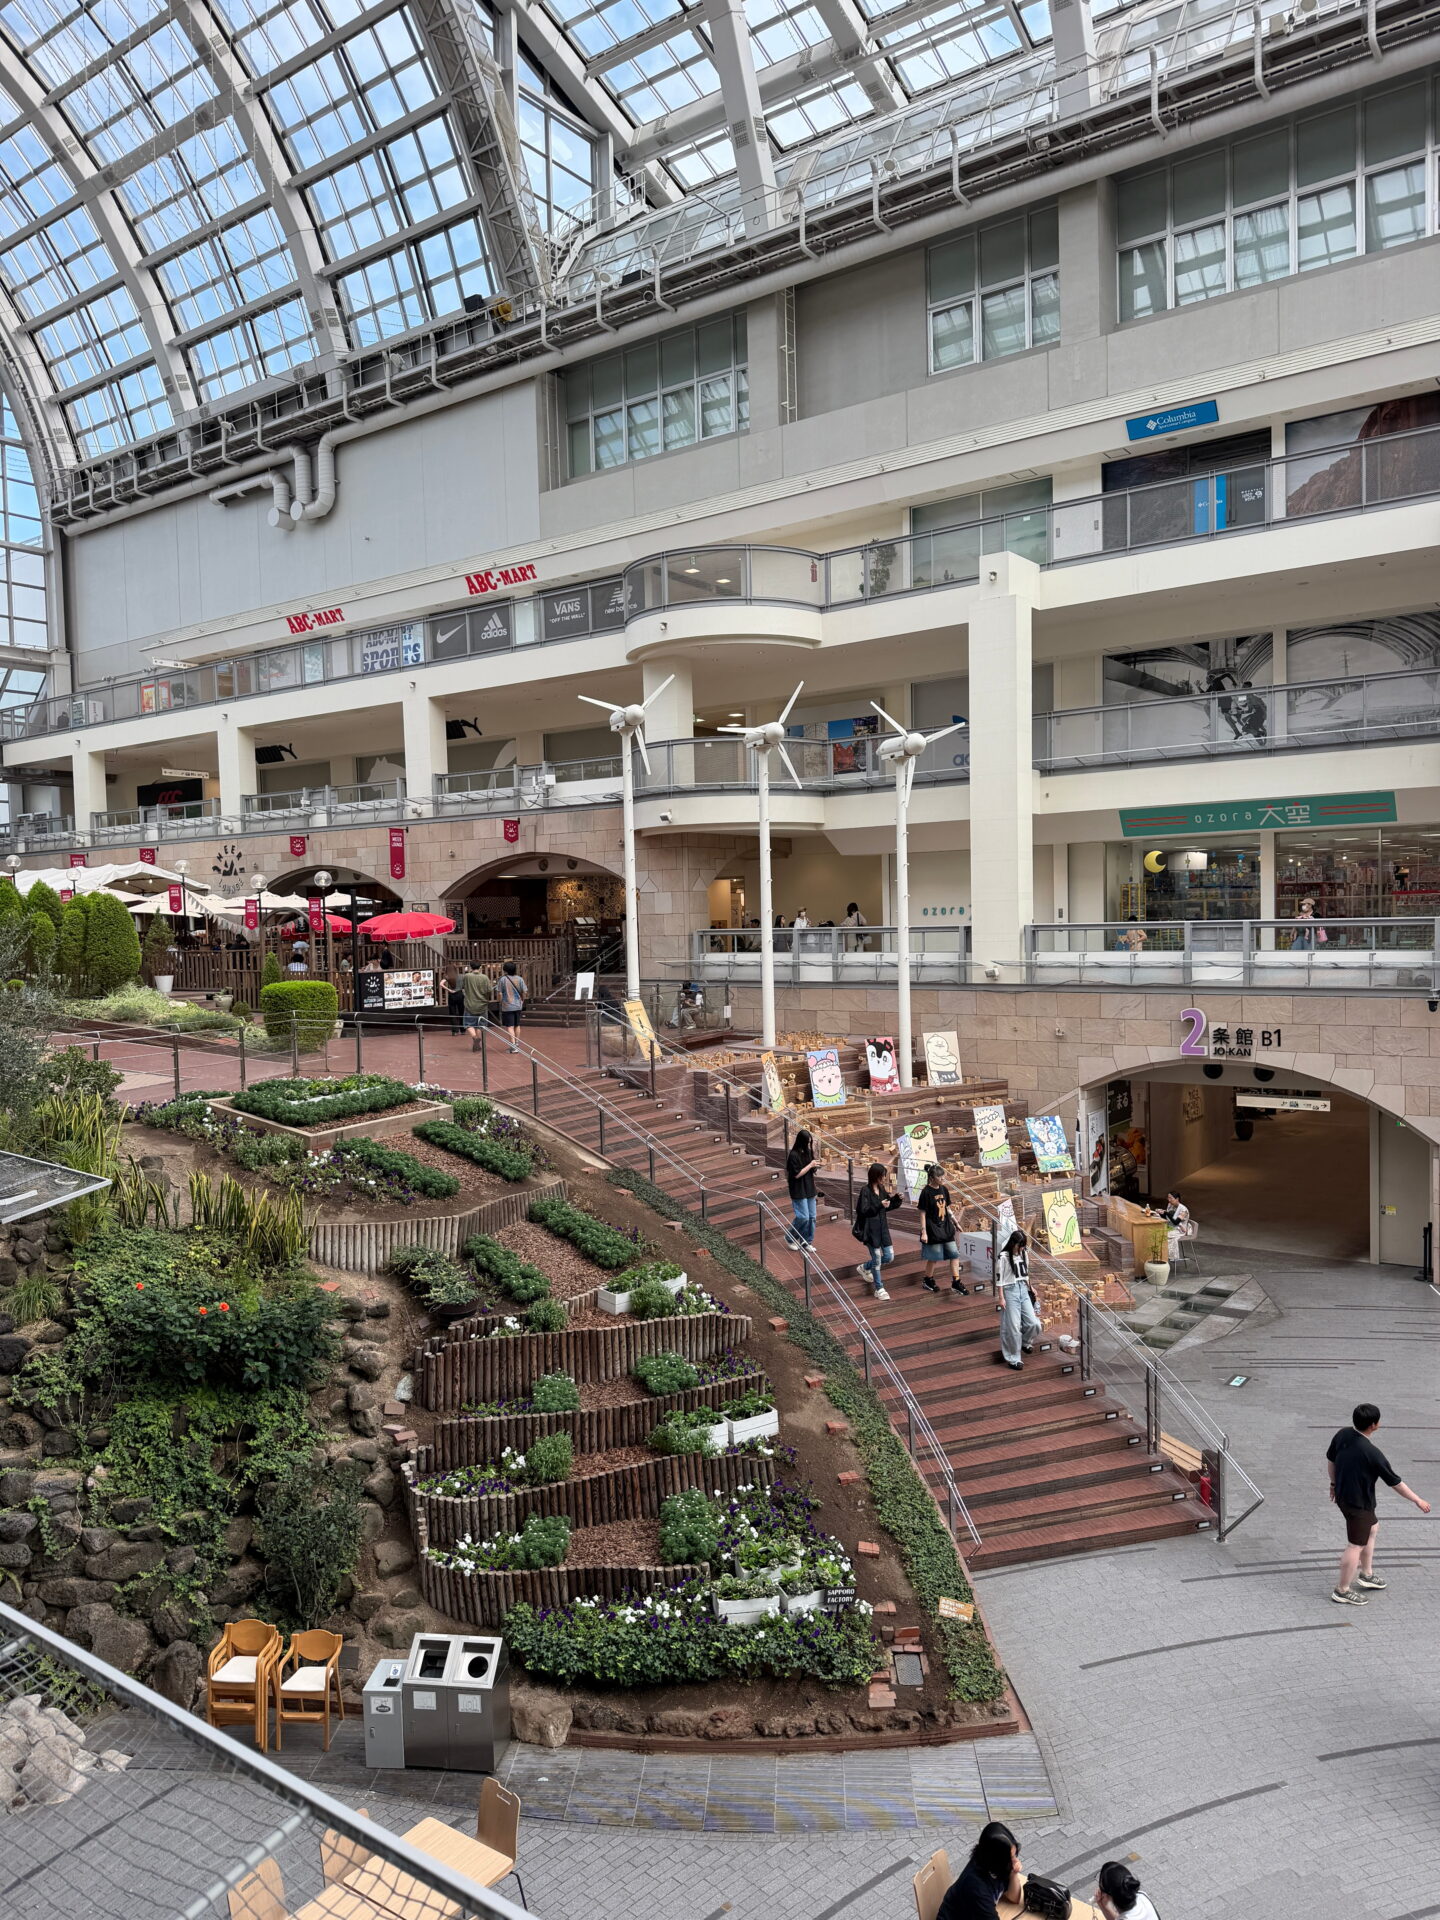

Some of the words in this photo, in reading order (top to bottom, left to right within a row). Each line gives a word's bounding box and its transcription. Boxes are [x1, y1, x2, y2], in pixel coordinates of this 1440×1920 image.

[1156, 411, 1196, 425] Columbia
[465, 564, 537, 595] ABC-MART
[554, 597, 581, 615] VANS
[286, 608, 346, 634] ABC-MART
[481, 628, 508, 640] adidas
[1194, 810, 1253, 824] ozora
[1257, 802, 1311, 826] 大空
[923, 906, 965, 917] ozora
[1261, 1029, 1282, 1047] B1
[1213, 1047, 1252, 1057] JO-KAN
[963, 1242, 976, 1256] 1F
[827, 1588, 855, 1596] SAPPORO
[827, 1596, 854, 1604] FACTORY
